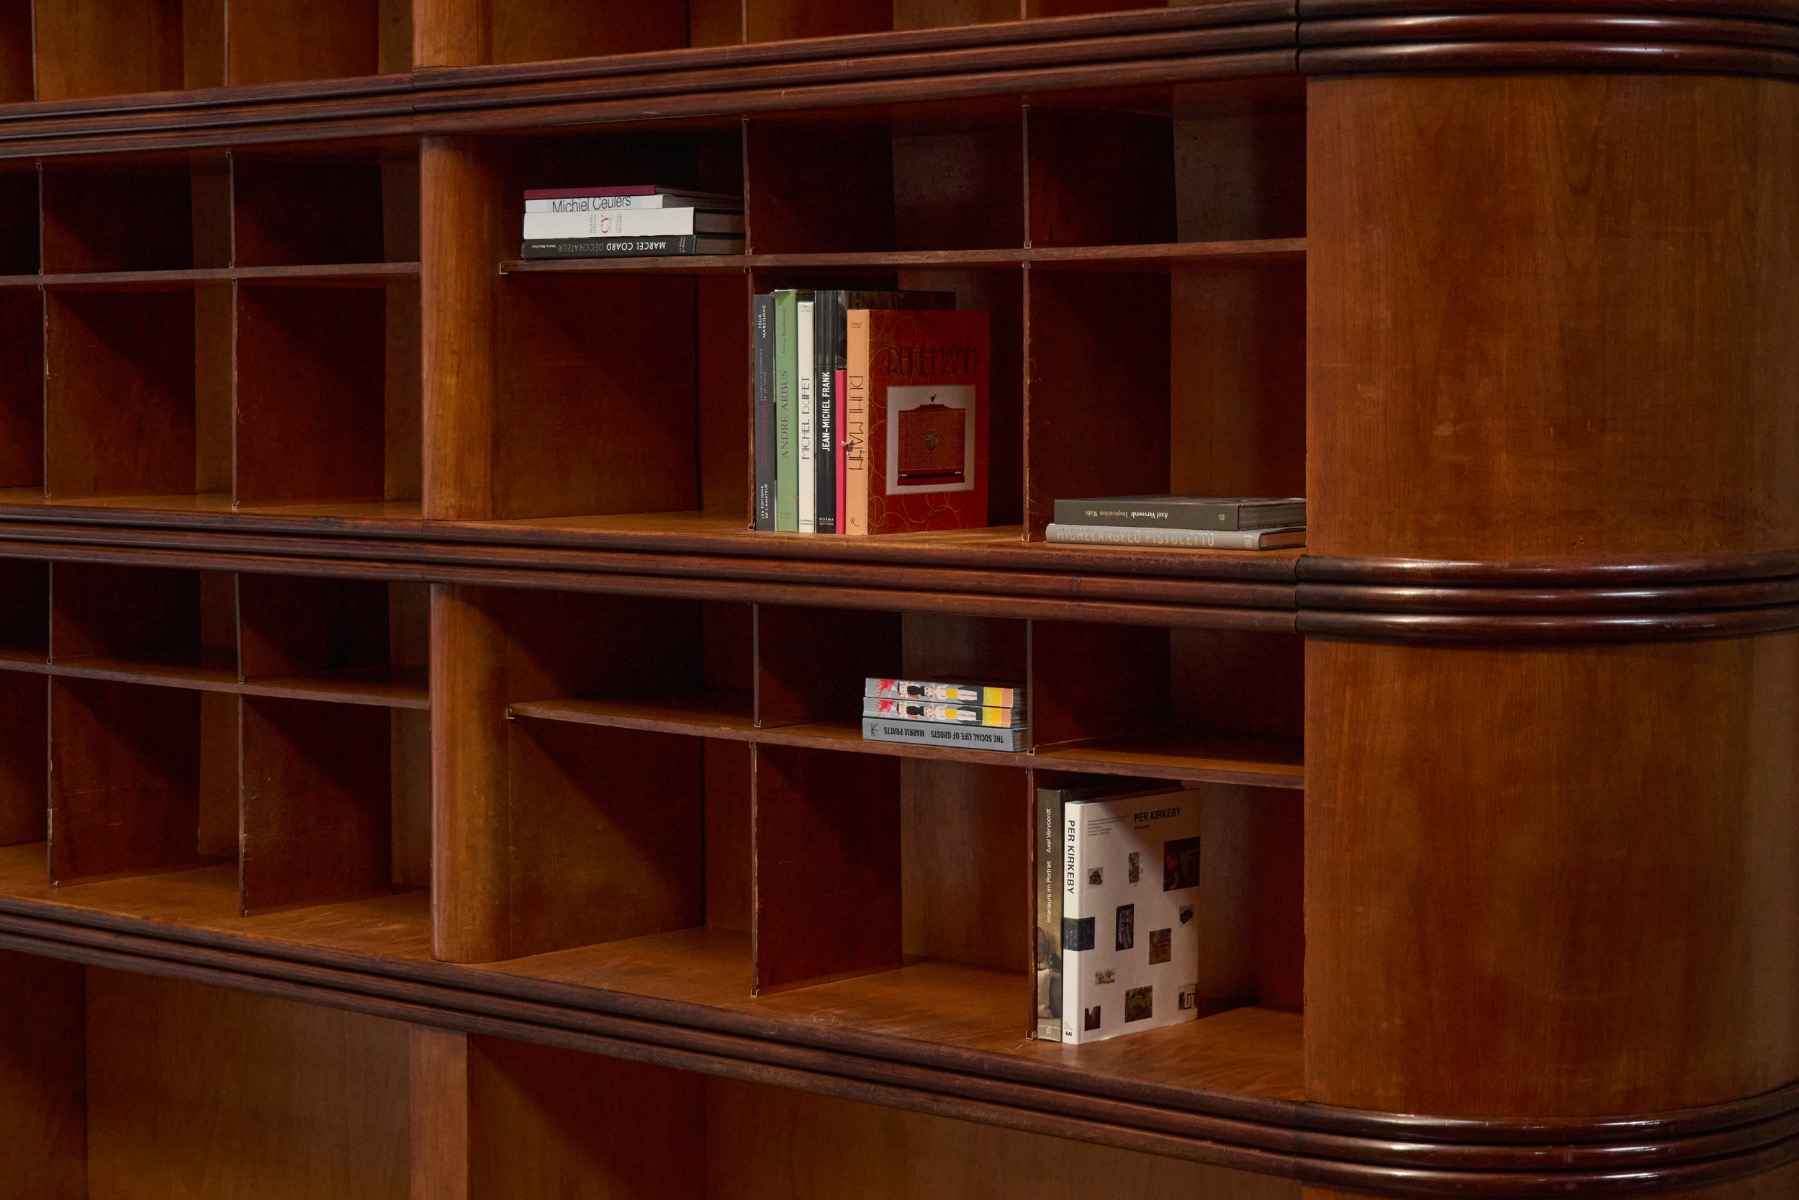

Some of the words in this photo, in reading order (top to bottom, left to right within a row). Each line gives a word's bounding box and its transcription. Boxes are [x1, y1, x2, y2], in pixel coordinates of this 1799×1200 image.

[552, 198, 590, 212] Michiel
[592, 196, 632, 211] Ceulers
[606, 242, 634, 251] COARD
[636, 241, 667, 251] MARCEL
[822, 371, 830, 398] FRANK
[822, 399, 830, 452] JEAN-MICHEL
[780, 416, 788, 459] ANDRÉ
[802, 418, 810, 460] MICHEL
[1056, 528, 1141, 544] MICHELANGELO
[1145, 531, 1215, 547] PISTOLETTO
[884, 726, 904, 735] PRATTS
[931, 730, 951, 739] GHOSTS
[953, 732, 960, 740] OF
[961, 732, 972, 741] LIFE
[973, 733, 992, 743] SOCIAL
[993, 735, 1004, 743] THE
[1134, 812, 1149, 823] PER
[1149, 807, 1182, 820] KIRKEBY
[1068, 820, 1076, 841] PER
[1067, 845, 1075, 895] KIRKEBY
